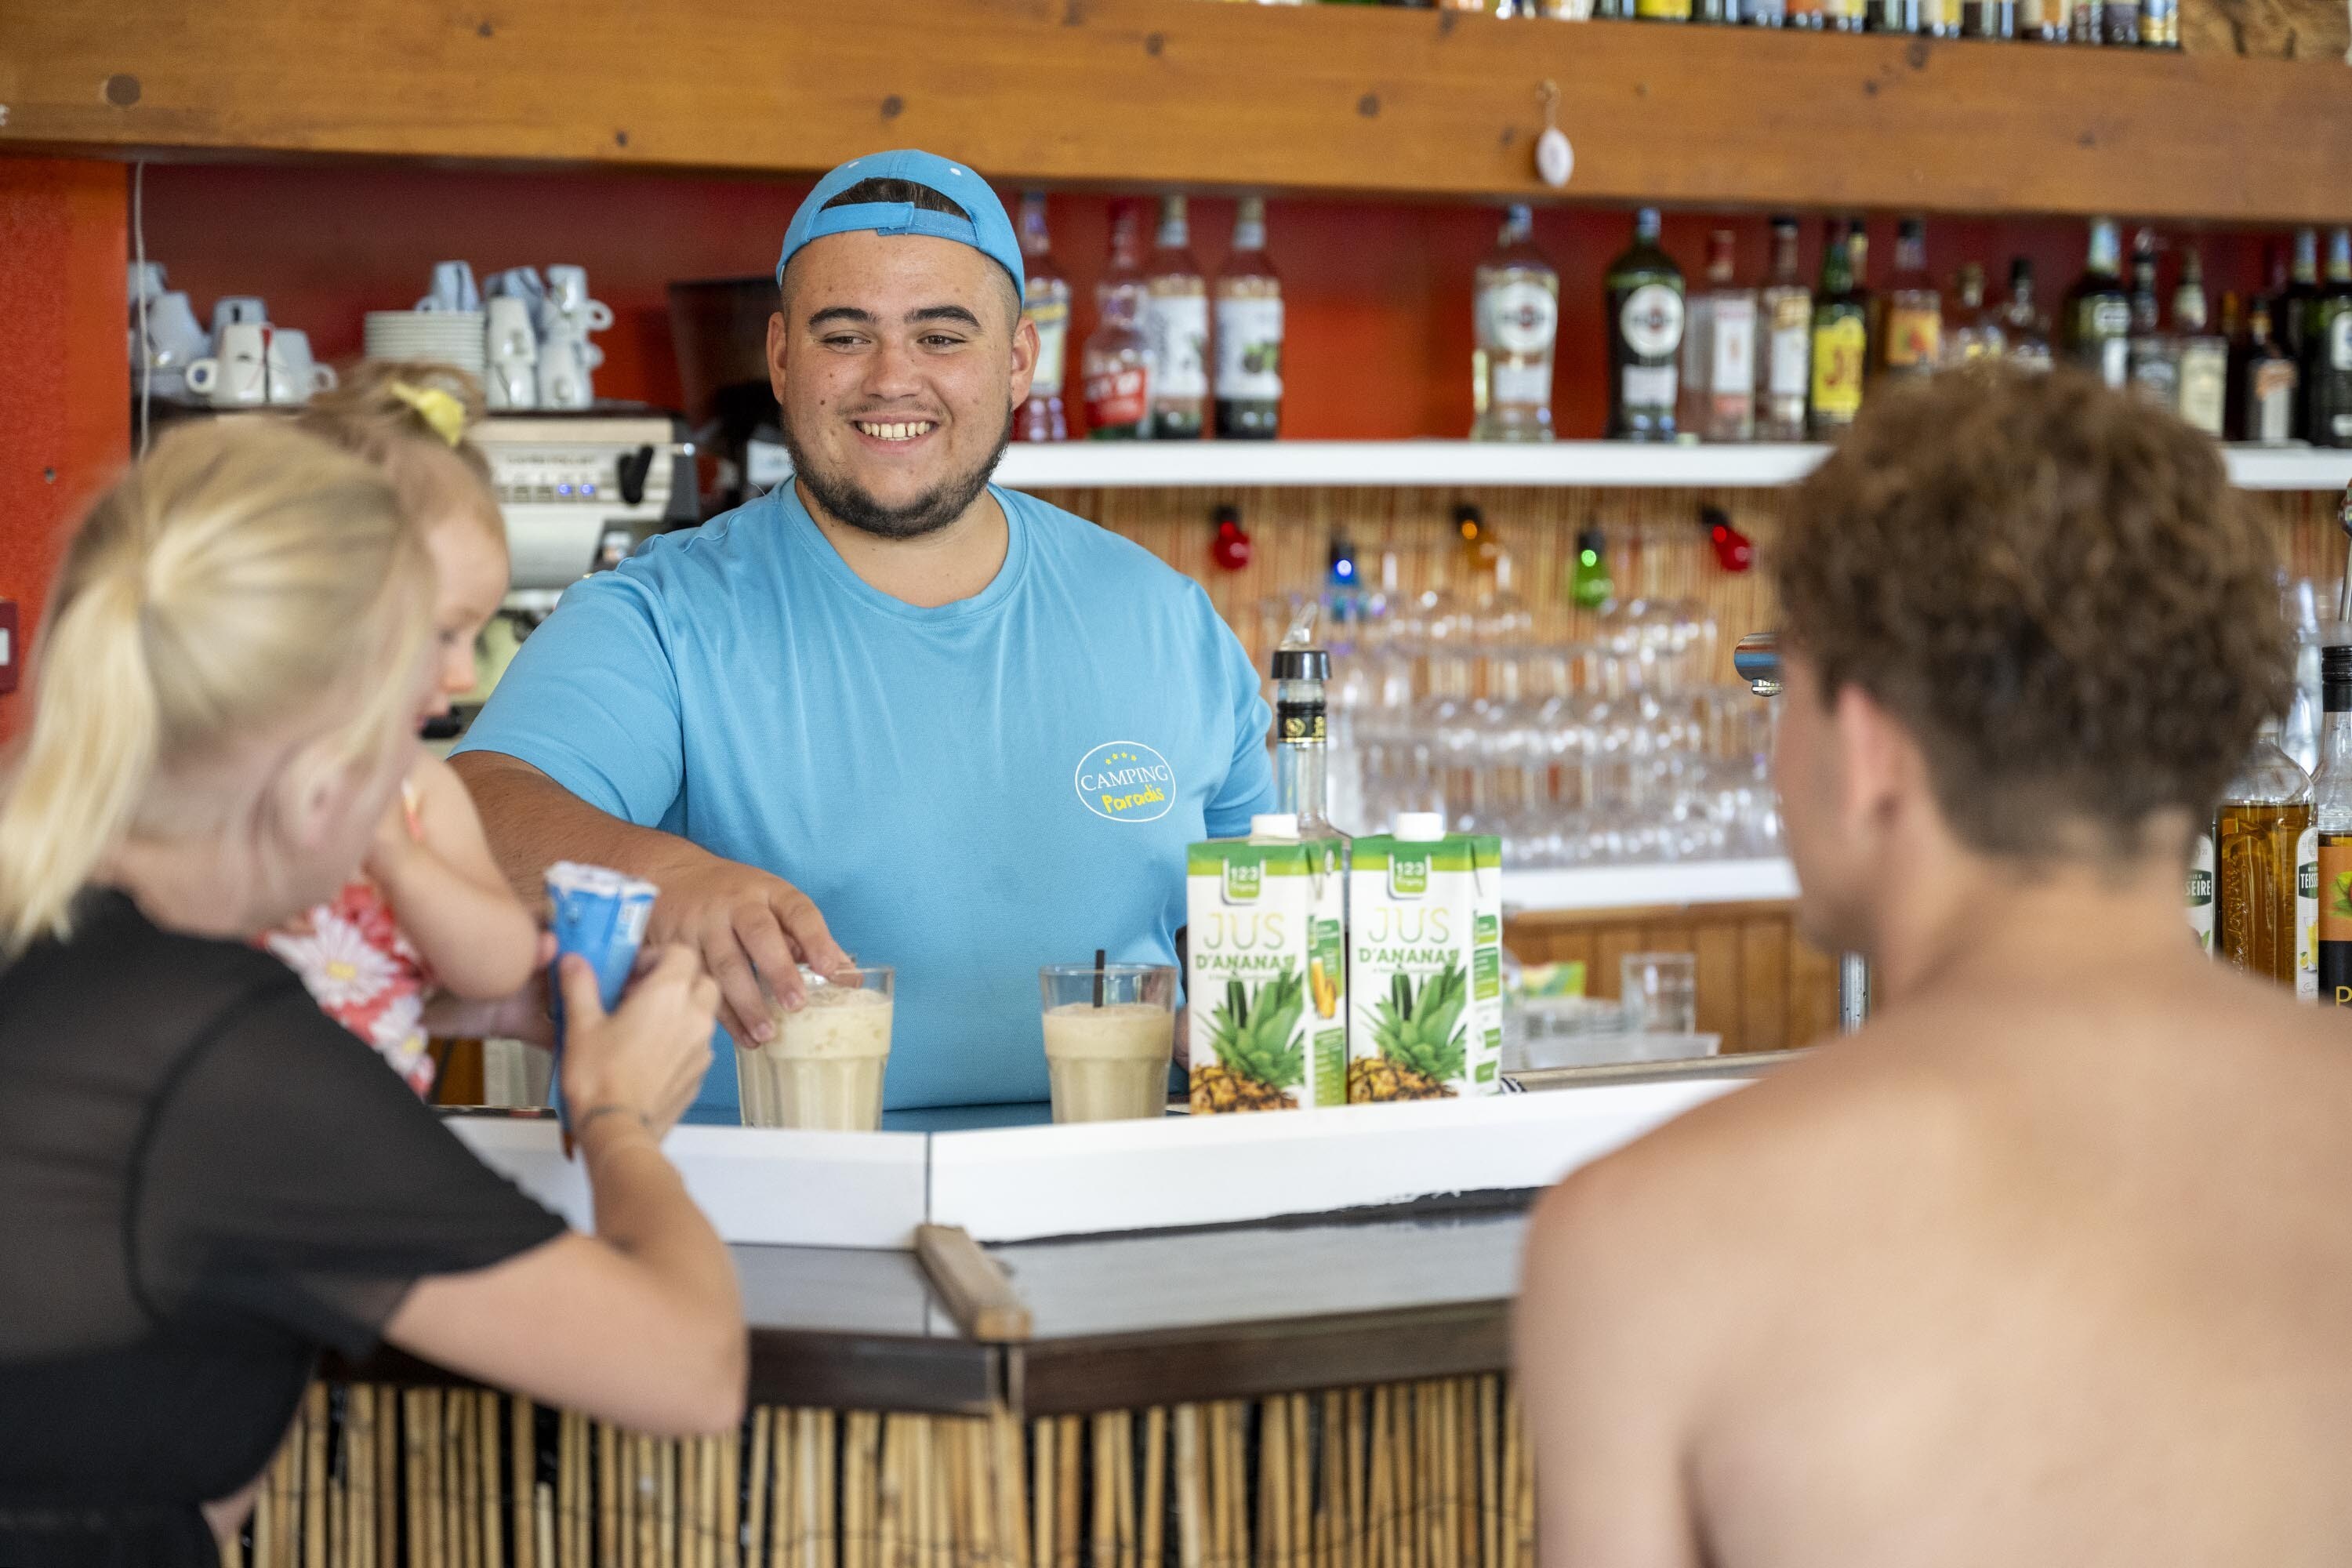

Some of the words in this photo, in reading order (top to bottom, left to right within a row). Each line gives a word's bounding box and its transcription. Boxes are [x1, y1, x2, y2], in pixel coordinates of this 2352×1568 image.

[1080, 765, 1168, 791] CAMPING
[1102, 784, 1165, 814] Paradis
[1229, 866, 1259, 882] 123
[1396, 861, 1425, 877] 123
[1203, 913, 1286, 950] JUS
[1368, 906, 1450, 944] JUS
